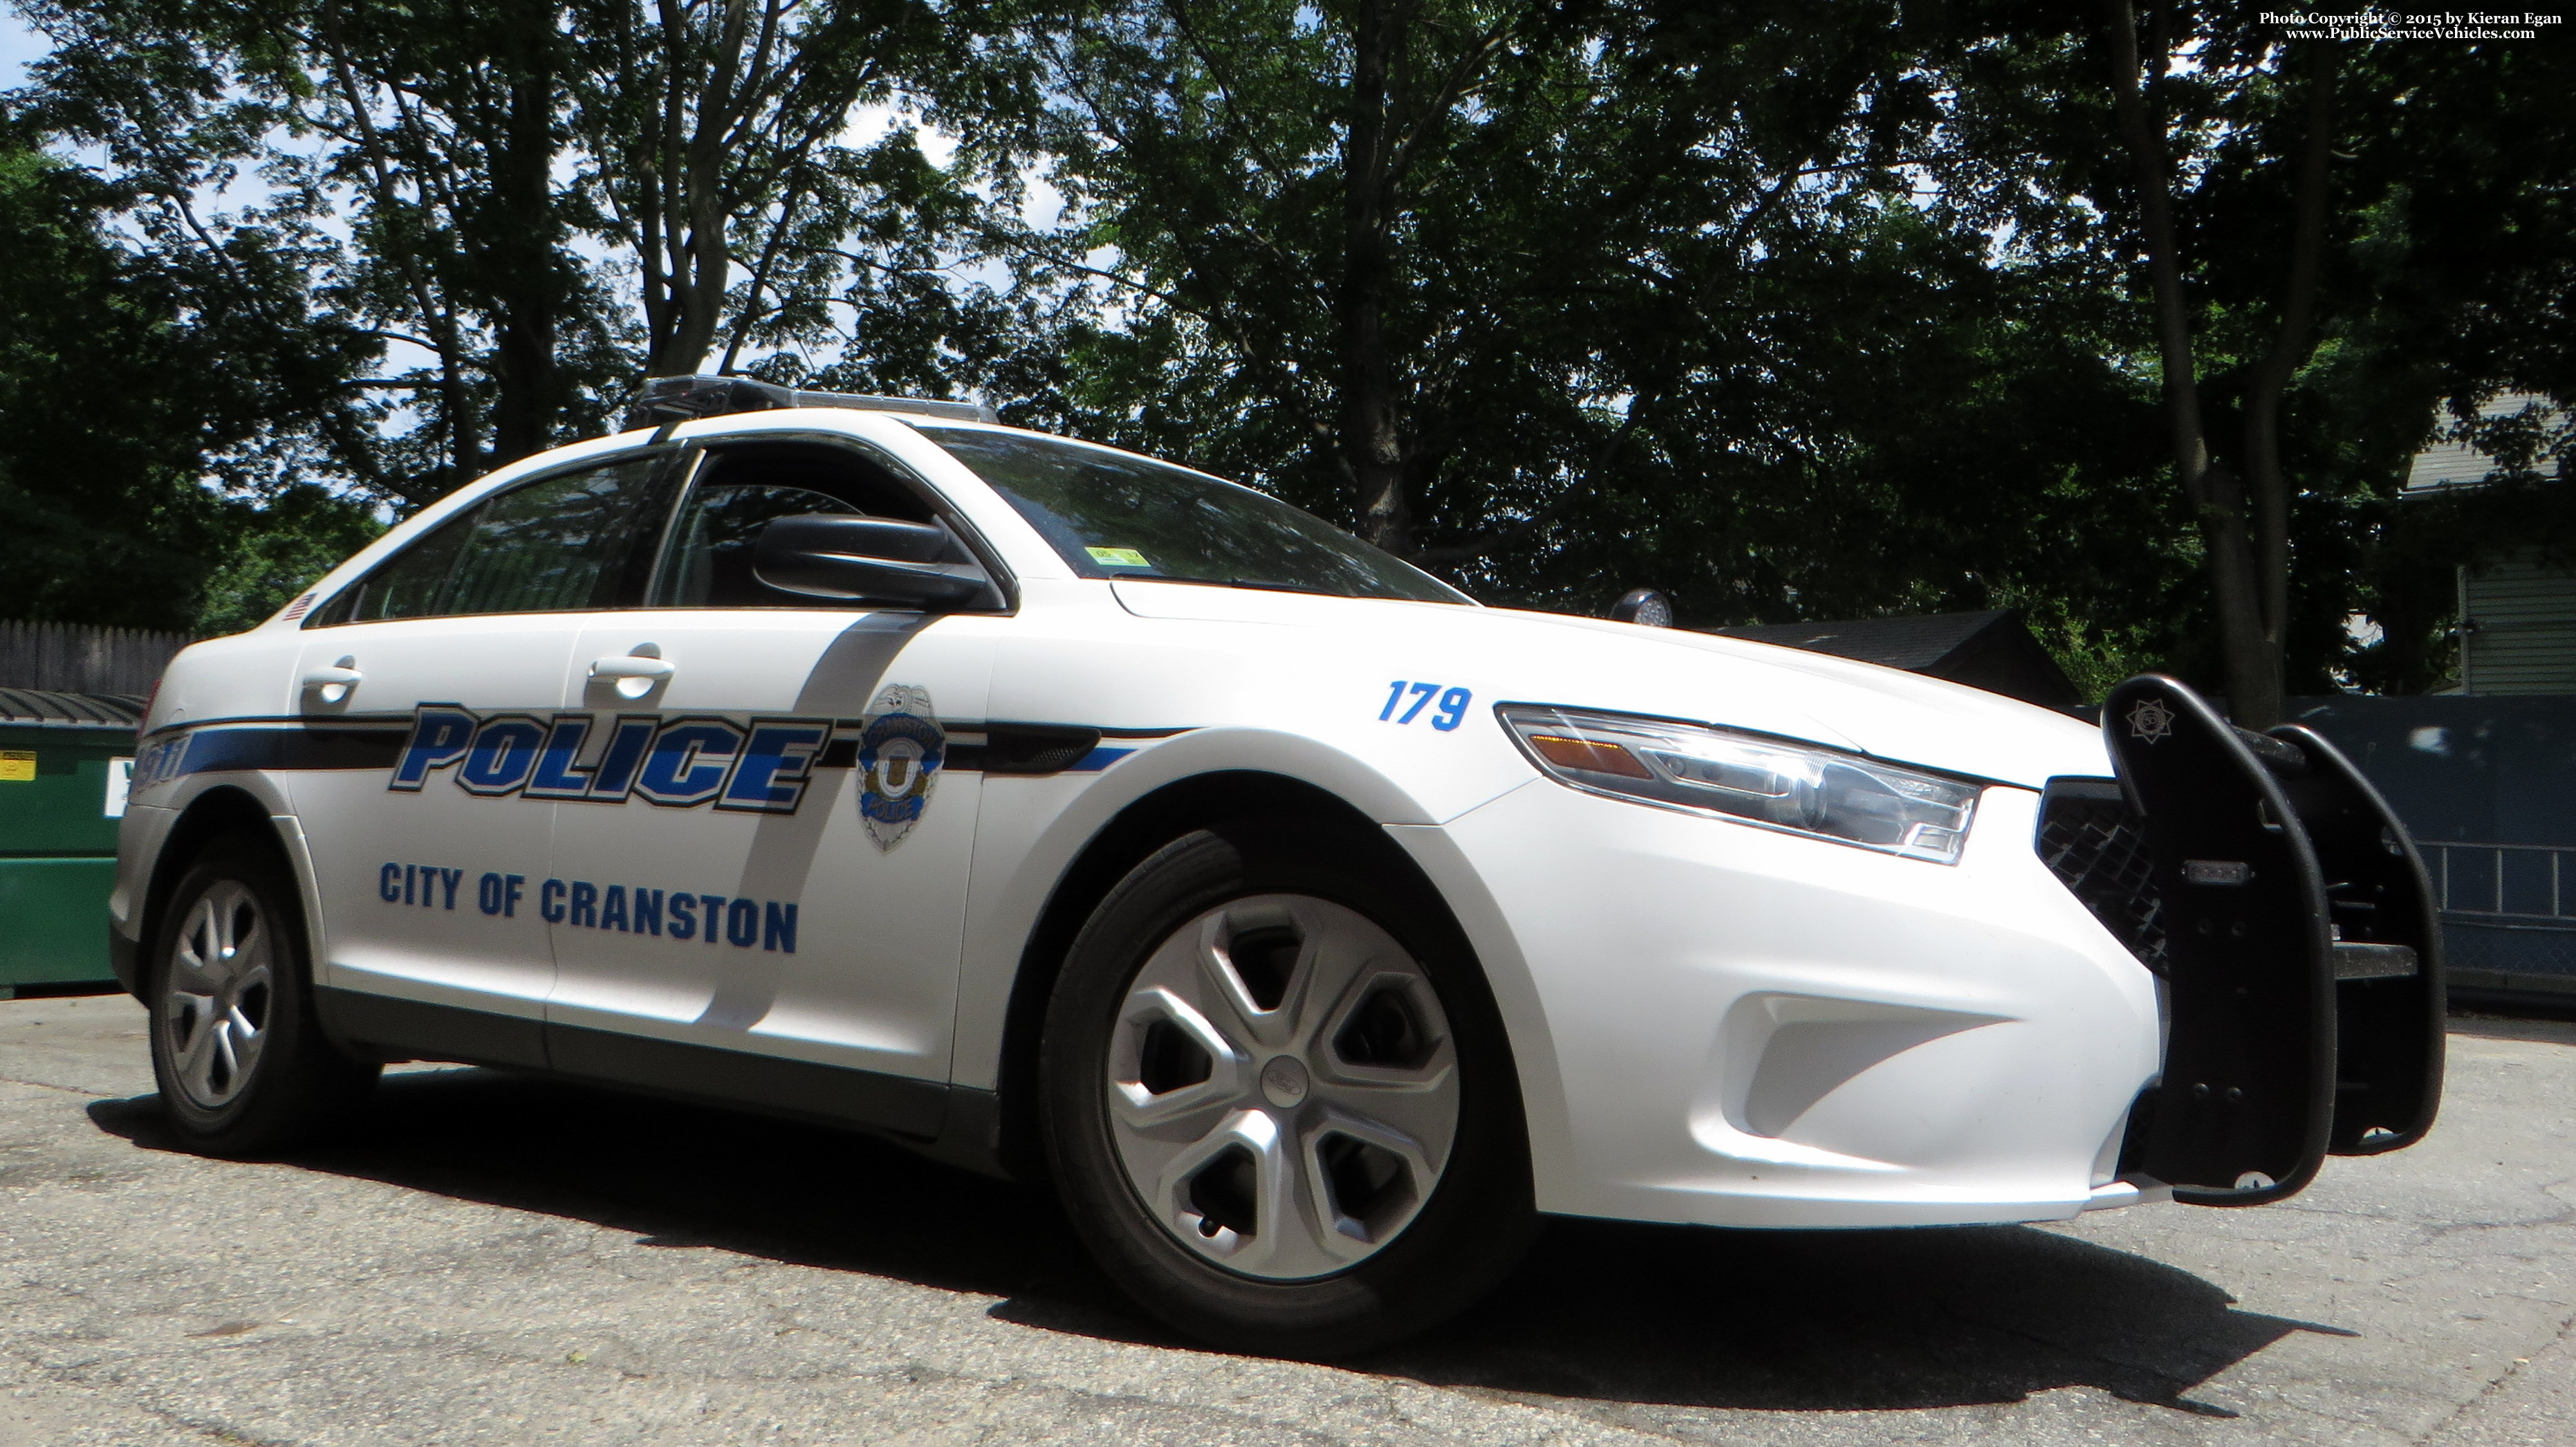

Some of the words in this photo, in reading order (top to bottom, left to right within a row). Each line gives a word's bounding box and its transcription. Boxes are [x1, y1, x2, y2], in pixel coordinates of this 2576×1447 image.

[1378, 680, 1472, 732] 179
[388, 701, 835, 815] POLICE
[869, 798, 914, 820] POLICE
[380, 862, 463, 910] CITY
[479, 872, 524, 918] OF
[541, 878, 799, 954] CRANSTON
